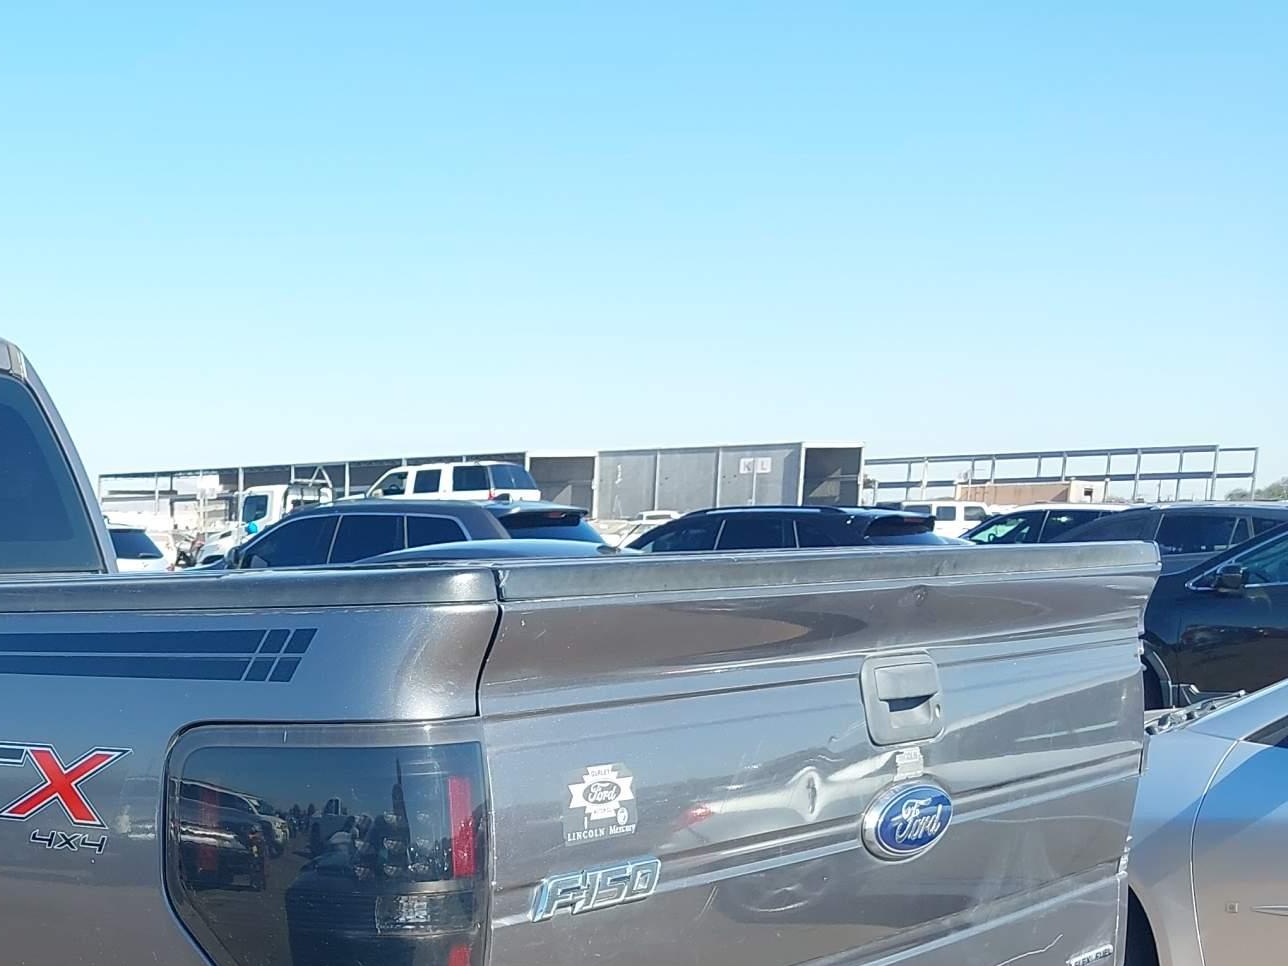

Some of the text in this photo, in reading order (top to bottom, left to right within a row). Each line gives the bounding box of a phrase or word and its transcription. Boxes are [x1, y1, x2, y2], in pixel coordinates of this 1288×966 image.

[587, 782, 618, 803] Ford
[891, 797, 944, 844] Ford
[567, 823, 637, 842] LINCOLN Mercury
[1095, 947, 1113, 961] FUEL
